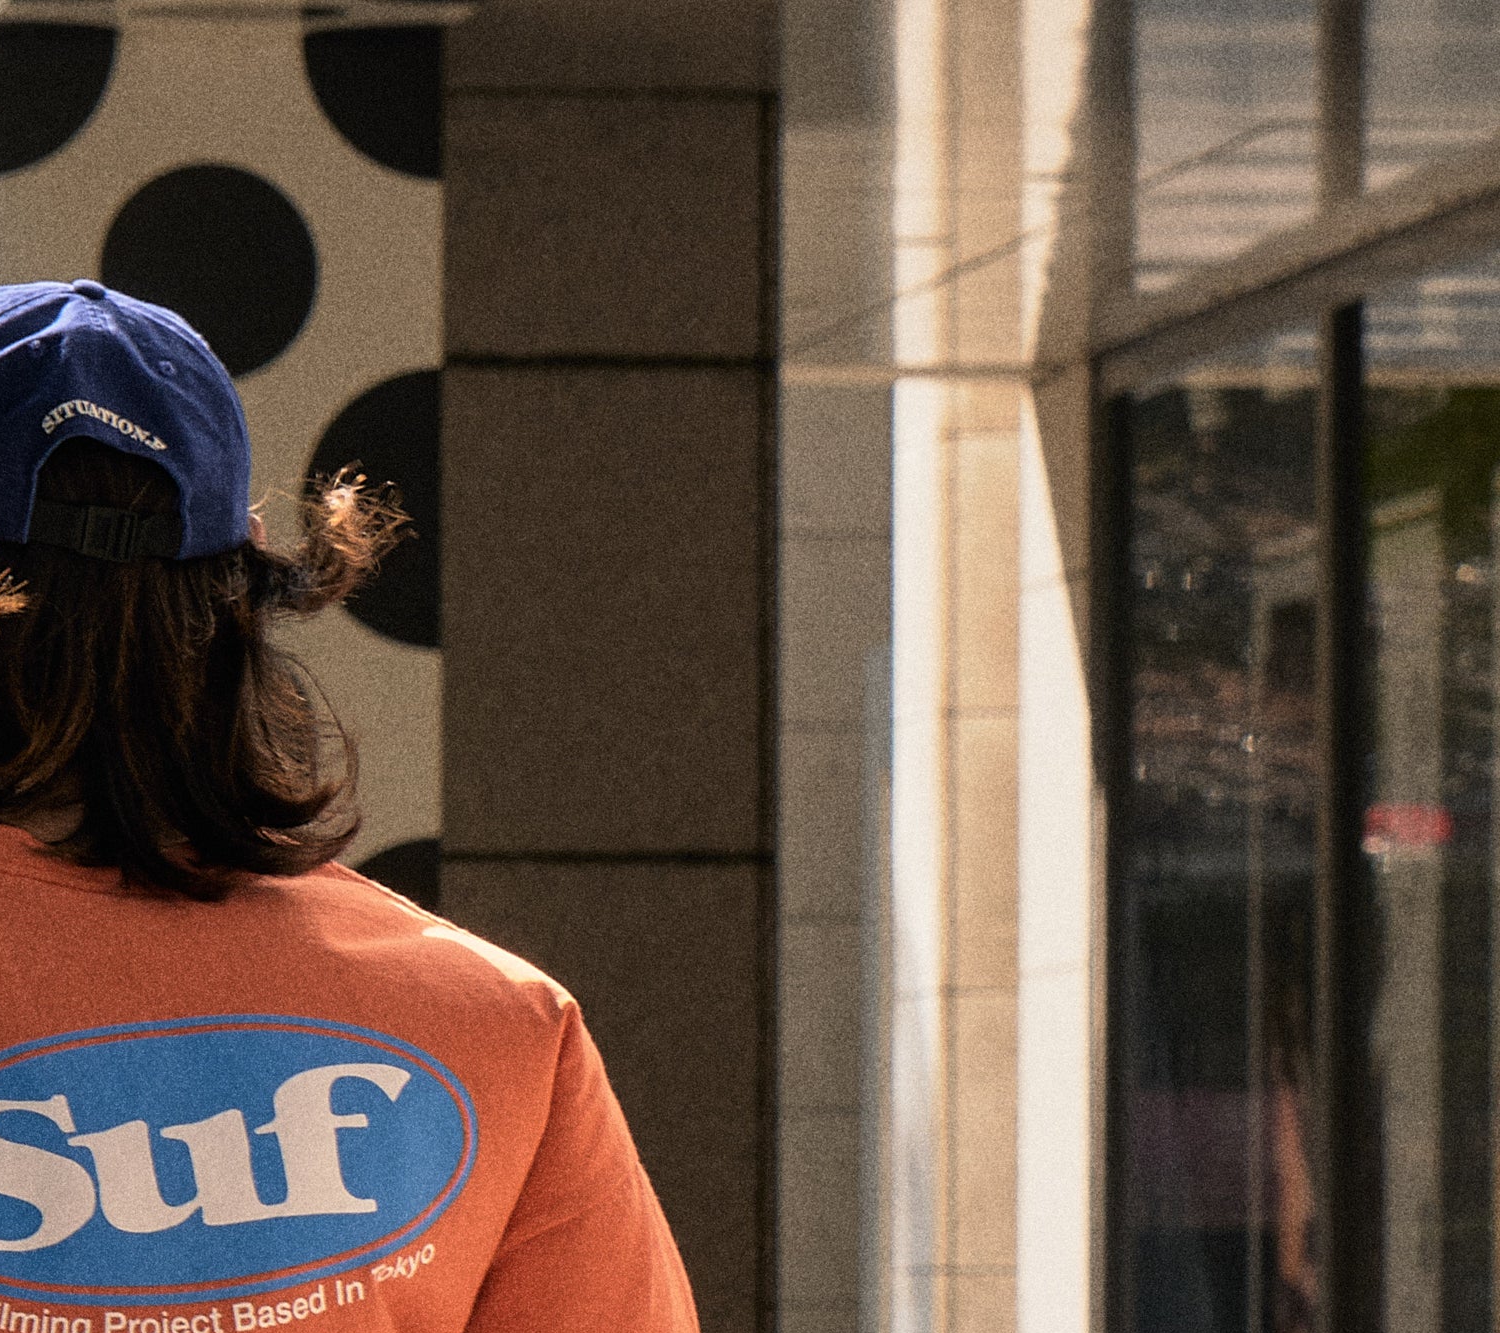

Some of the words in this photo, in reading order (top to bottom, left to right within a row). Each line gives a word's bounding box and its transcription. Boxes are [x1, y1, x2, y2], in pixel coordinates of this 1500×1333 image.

[232, 1284, 327, 1333] Based
[335, 1279, 365, 1306] In
[371, 1243, 435, 1283] Tokyo
